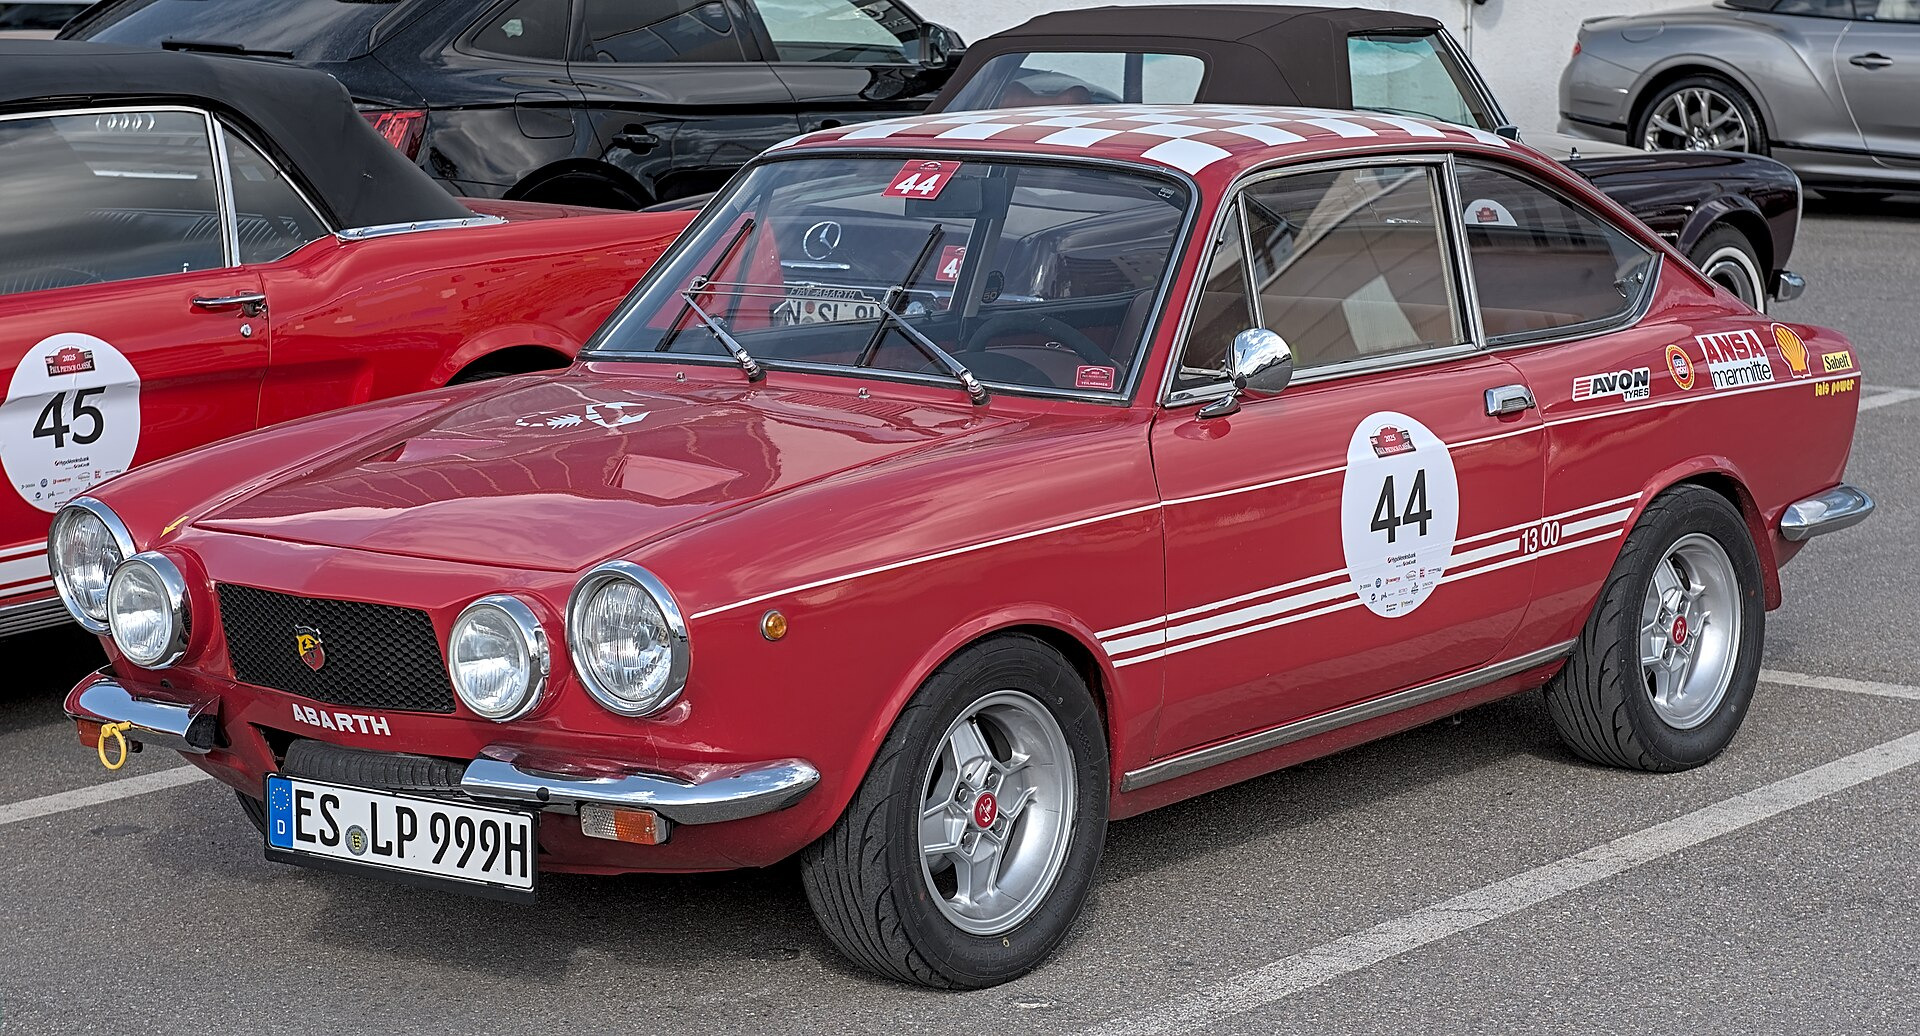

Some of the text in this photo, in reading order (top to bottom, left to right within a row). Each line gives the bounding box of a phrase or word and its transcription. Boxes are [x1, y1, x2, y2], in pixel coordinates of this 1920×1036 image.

[894, 173, 941, 195] 44
[62, 353, 76, 362] 2025
[1701, 332, 1765, 364] ANSA
[1712, 361, 1772, 387] marmitte
[1825, 353, 1850, 370] Sabelt
[1592, 370, 1649, 394] AVON
[1624, 388, 1649, 399] TYRES
[33, 386, 107, 448] 45
[1384, 433, 1397, 442] 2025
[1371, 469, 1432, 543] 44
[292, 703, 391, 736] ABARTH
[277, 789, 528, 878] D ES LP 999H
